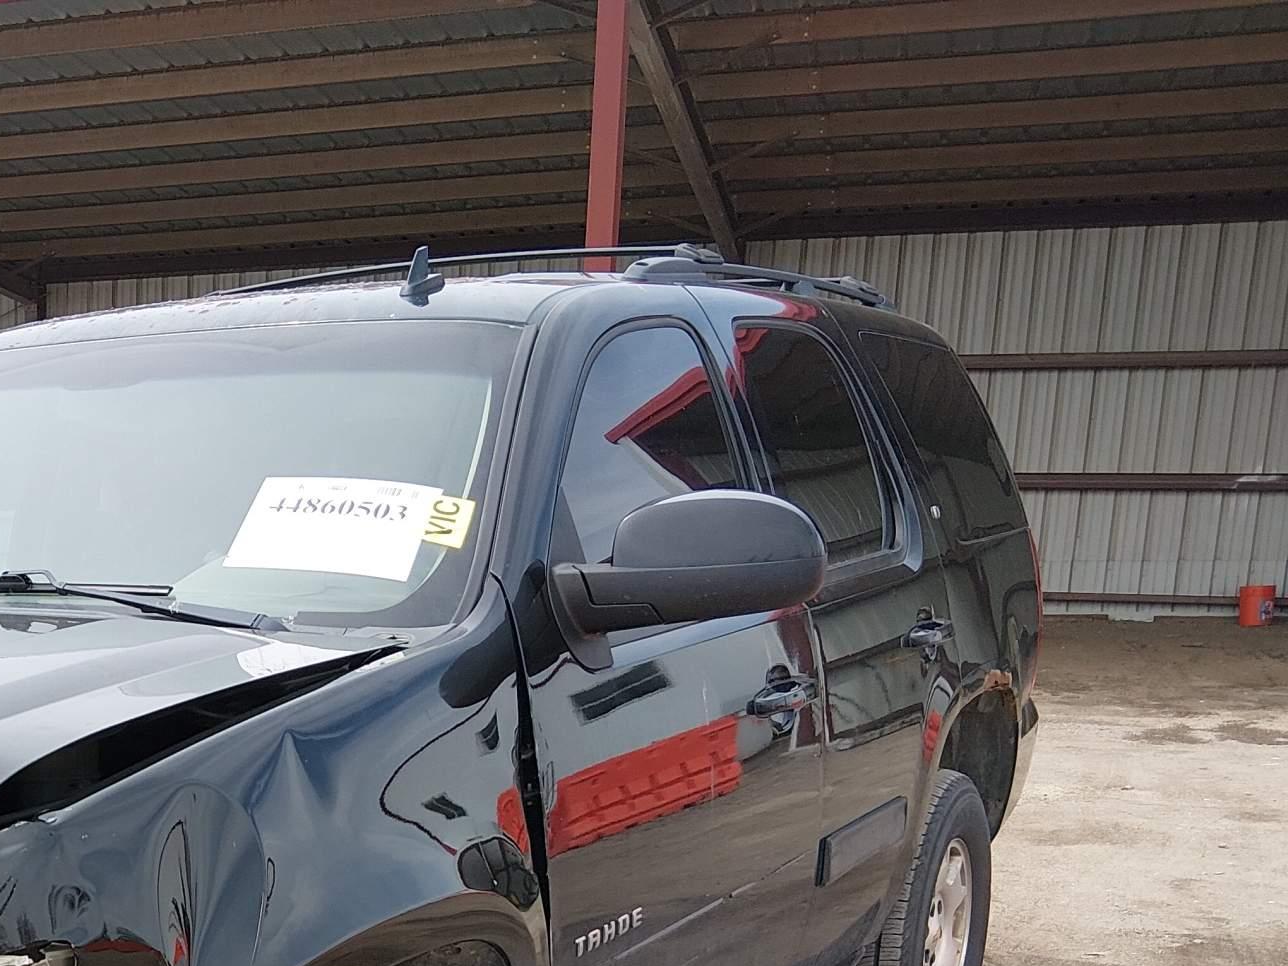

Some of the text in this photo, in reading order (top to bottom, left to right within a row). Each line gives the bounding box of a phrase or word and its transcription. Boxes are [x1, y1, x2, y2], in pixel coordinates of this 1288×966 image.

[269, 497, 408, 521] 44860503
[424, 500, 460, 535] VIC
[575, 906, 643, 958] TAHOE
